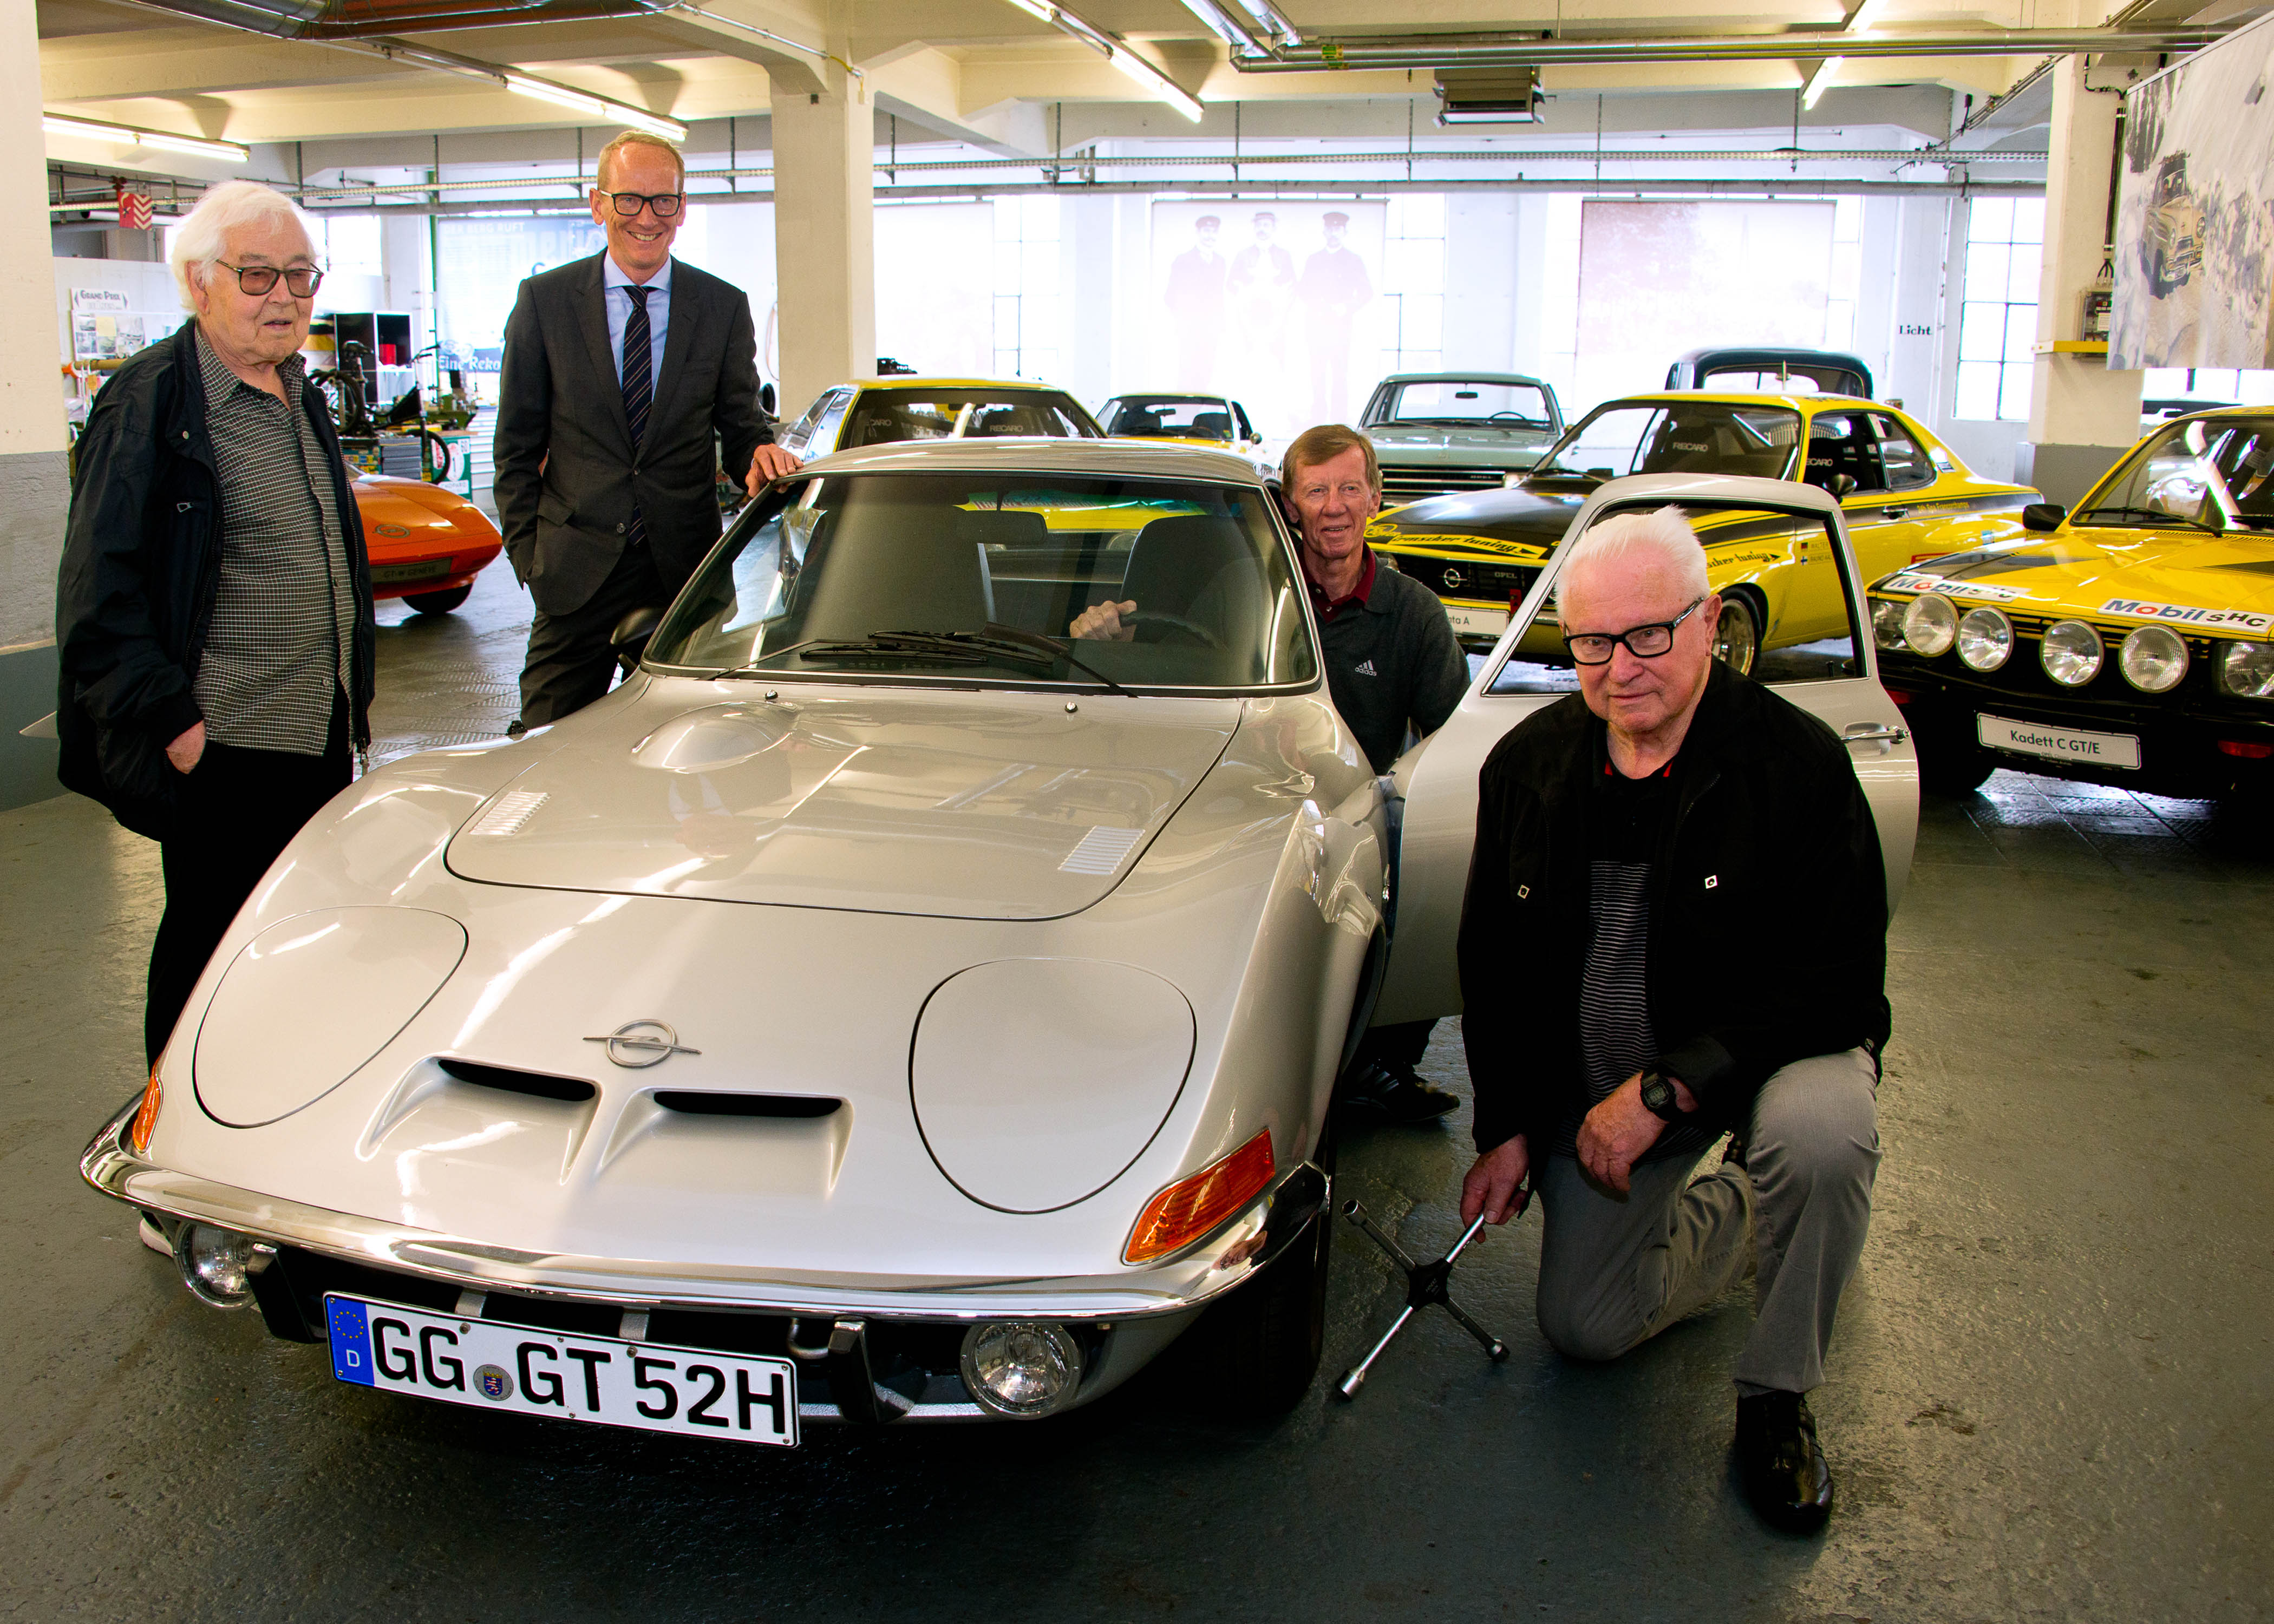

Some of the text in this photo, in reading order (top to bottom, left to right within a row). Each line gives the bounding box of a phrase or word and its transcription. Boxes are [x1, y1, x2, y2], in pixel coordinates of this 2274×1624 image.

[497, 222, 525, 233] RUFT
[80, 290, 103, 299] GRAND
[1899, 324, 1932, 336] Licht
[438, 355, 501, 370] Eine Reko
[1672, 441, 1708, 452] RECARO
[1806, 457, 1834, 467] ECARO
[1463, 536, 1518, 554] tuning
[1707, 551, 1770, 567] scher tuning
[1889, 577, 1968, 594] Mobil
[1448, 615, 1470, 625] nta A
[2105, 600, 2266, 627] Mobil SHC
[1355, 667, 1377, 677] adidas
[2010, 730, 2101, 754] Kadett C GT/E
[346, 1349, 361, 1367] D
[372, 1317, 785, 1435] GG GT 52H
